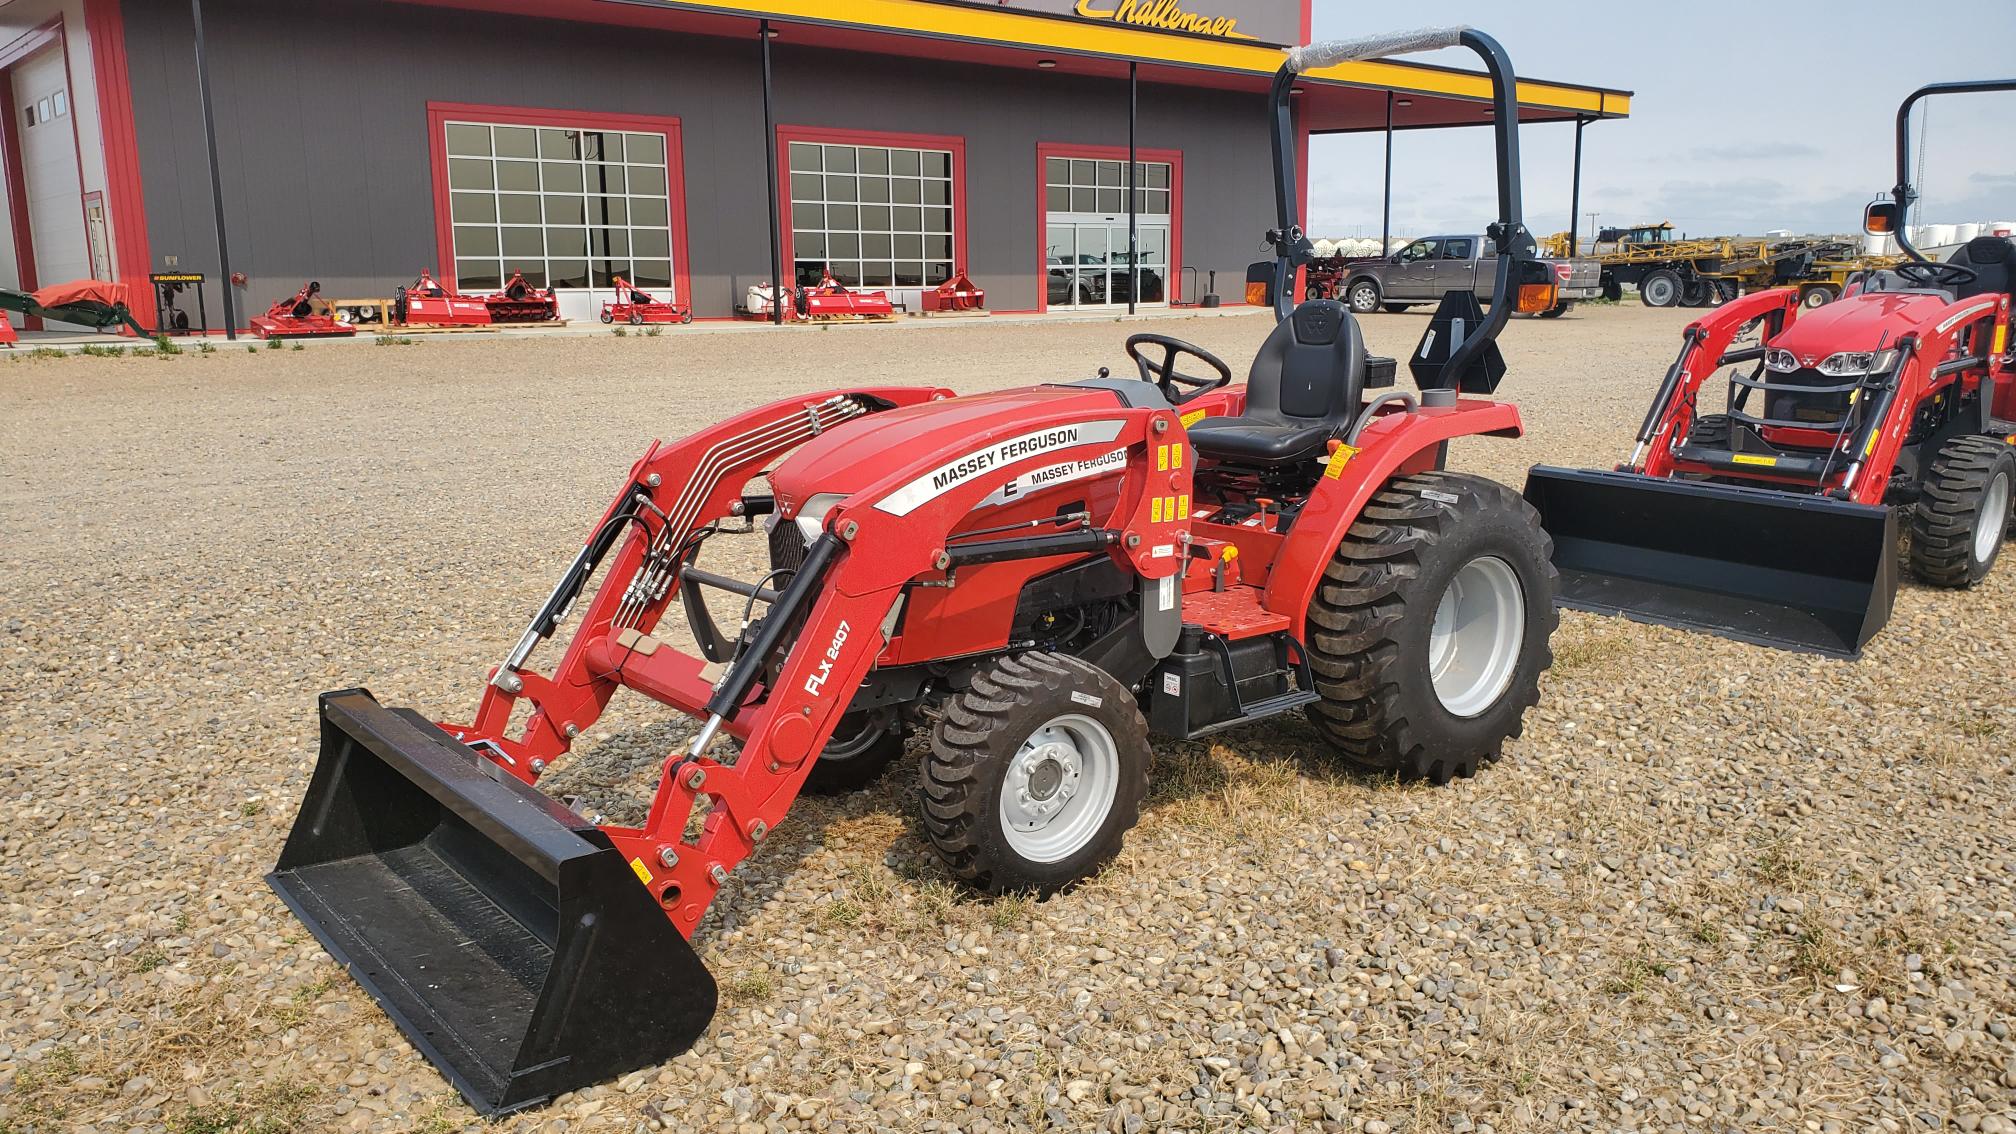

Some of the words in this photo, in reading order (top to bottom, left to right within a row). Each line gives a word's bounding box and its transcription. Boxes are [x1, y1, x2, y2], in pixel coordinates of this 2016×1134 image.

[933, 450, 996, 490] MASSEY
[1001, 428, 1078, 461] FERGUSON
[1031, 463, 1074, 485] MASSEY
[804, 658, 834, 697] FLX
[826, 619, 851, 661] 2407
